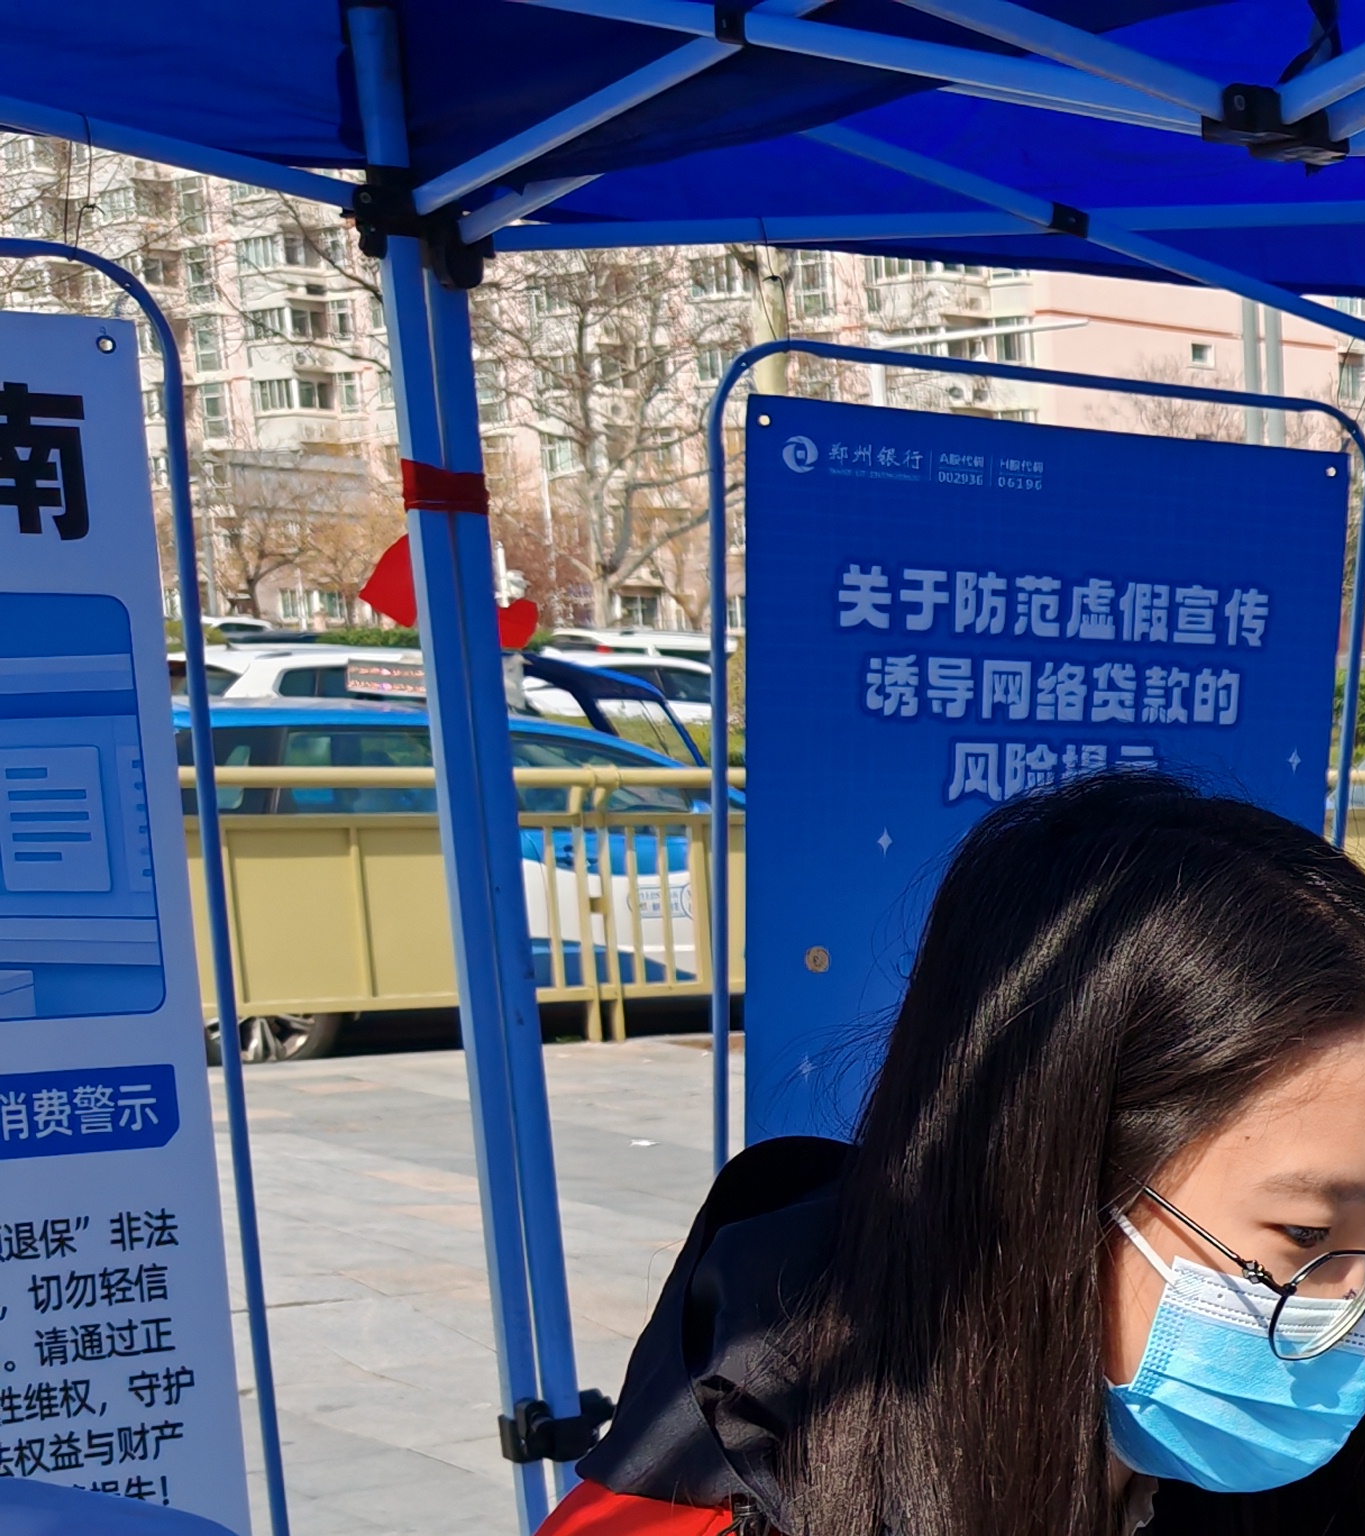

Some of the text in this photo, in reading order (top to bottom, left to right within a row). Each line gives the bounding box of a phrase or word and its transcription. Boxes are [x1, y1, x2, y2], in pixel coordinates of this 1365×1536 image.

[828, 442, 923, 470] 郑州银行
[938, 471, 984, 486] 002936
[838, 563, 1270, 648] 关于防范虚假宣传
[865, 655, 1241, 726] 诱导网络贷款的
[0, 1208, 179, 1263] 退保”非法
